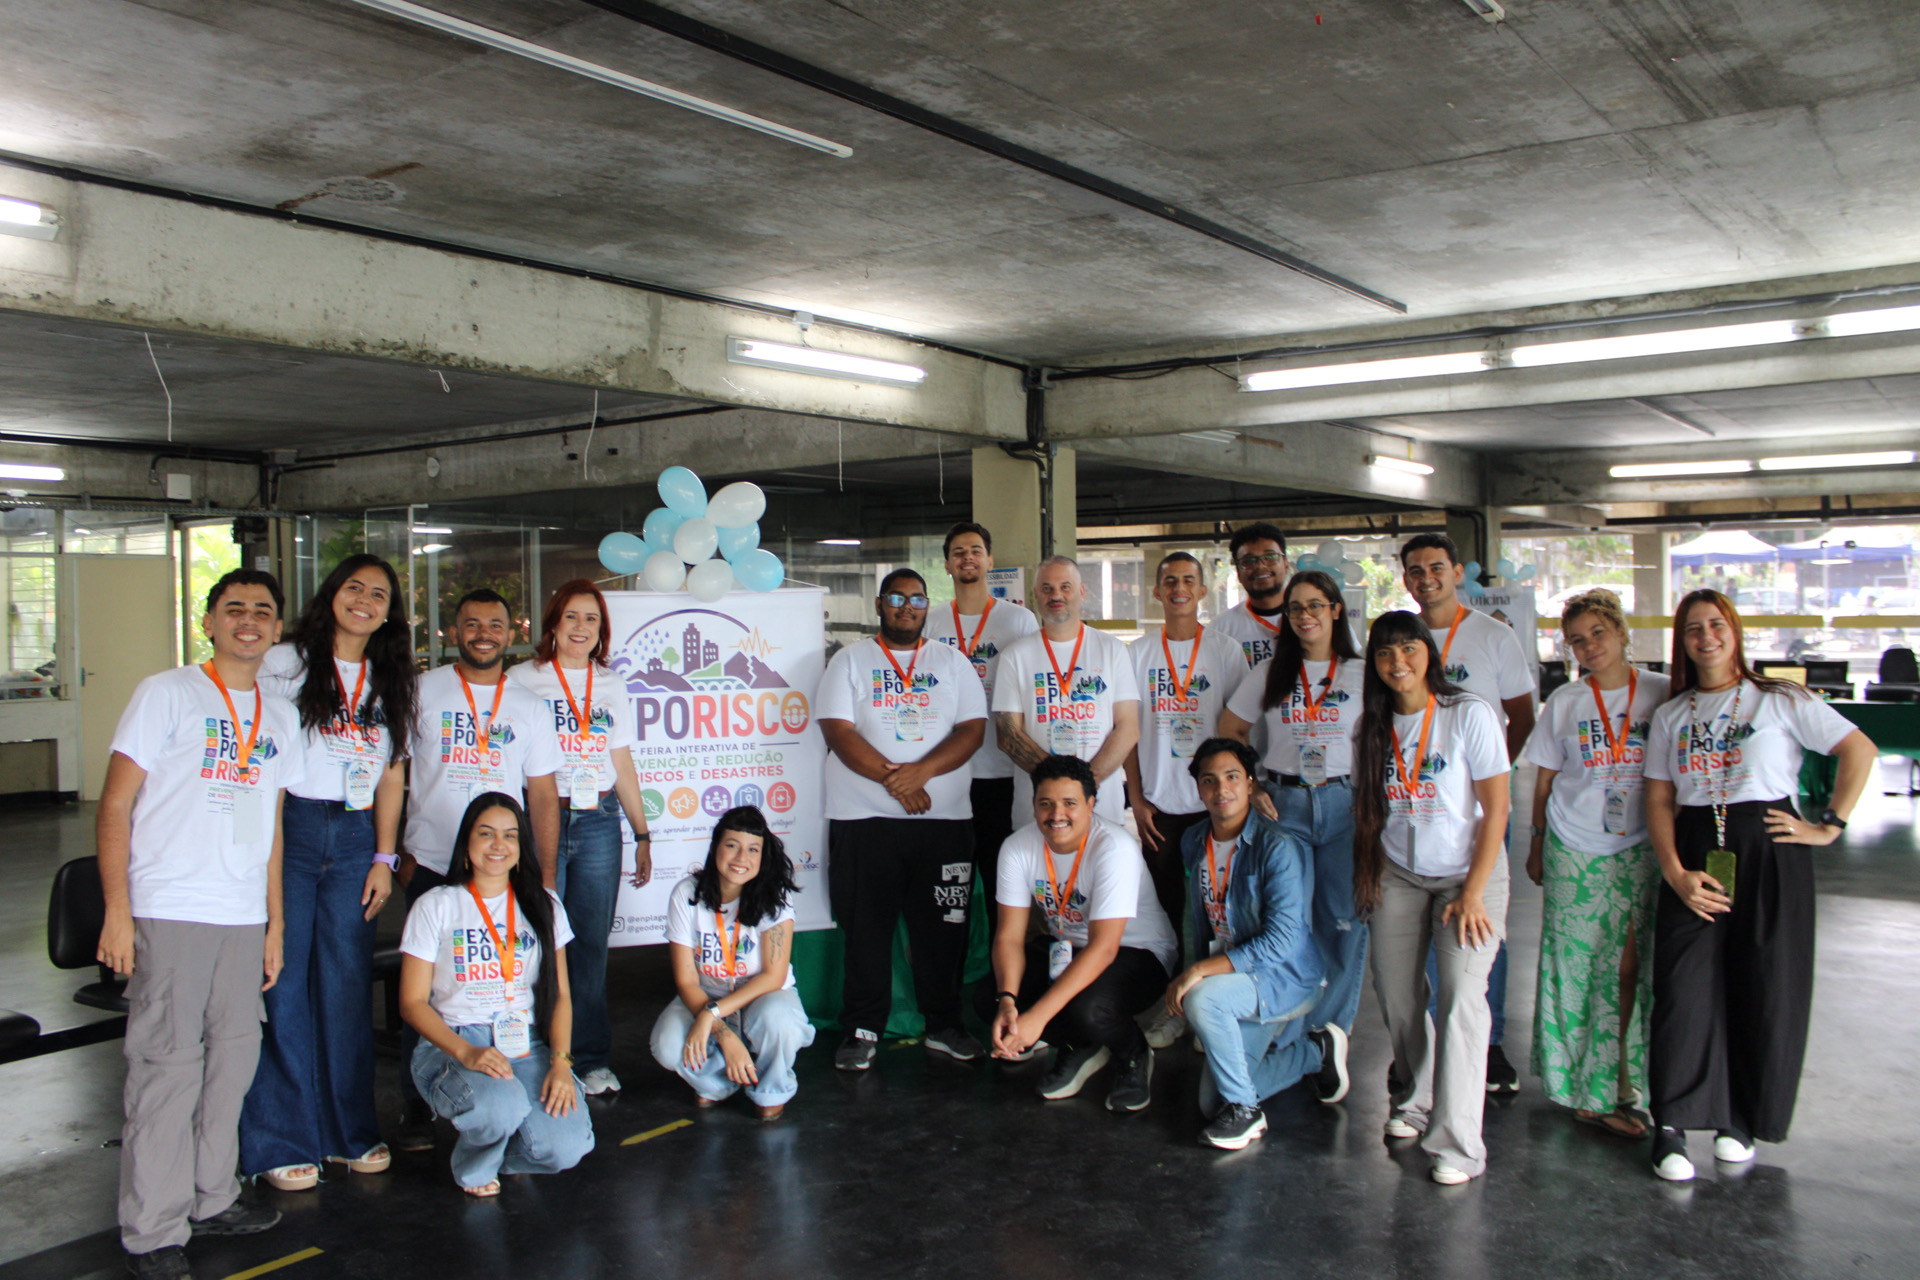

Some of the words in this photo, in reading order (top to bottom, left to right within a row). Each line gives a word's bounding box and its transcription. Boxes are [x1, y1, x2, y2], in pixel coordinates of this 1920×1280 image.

[1252, 639, 1272, 653] EX
[883, 669, 903, 681] EX
[884, 681, 904, 694] PO
[1157, 682, 1176, 697] PO
[455, 712, 476, 729] EX
[555, 715, 579, 733] PO
[629, 691, 810, 741] PORISCO
[454, 729, 476, 746] PO
[220, 738, 239, 760] PO
[453, 746, 502, 767] RISO
[640, 746, 672, 755] FEIRA
[676, 743, 739, 754] INTERATIVA
[742, 742, 756, 750] DE
[703, 756, 711, 765] E
[716, 750, 784, 766] REDUÇÃO
[216, 759, 260, 785] RISO
[637, 770, 685, 784] ISCOS
[689, 771, 696, 779] E
[701, 765, 784, 780] DESASTRES
[945, 865, 969, 876] NEW
[466, 928, 491, 944] EX
[467, 944, 492, 962] PO
[702, 949, 723, 963] PO
[468, 959, 524, 981] RISO
[702, 962, 748, 978] RISO
